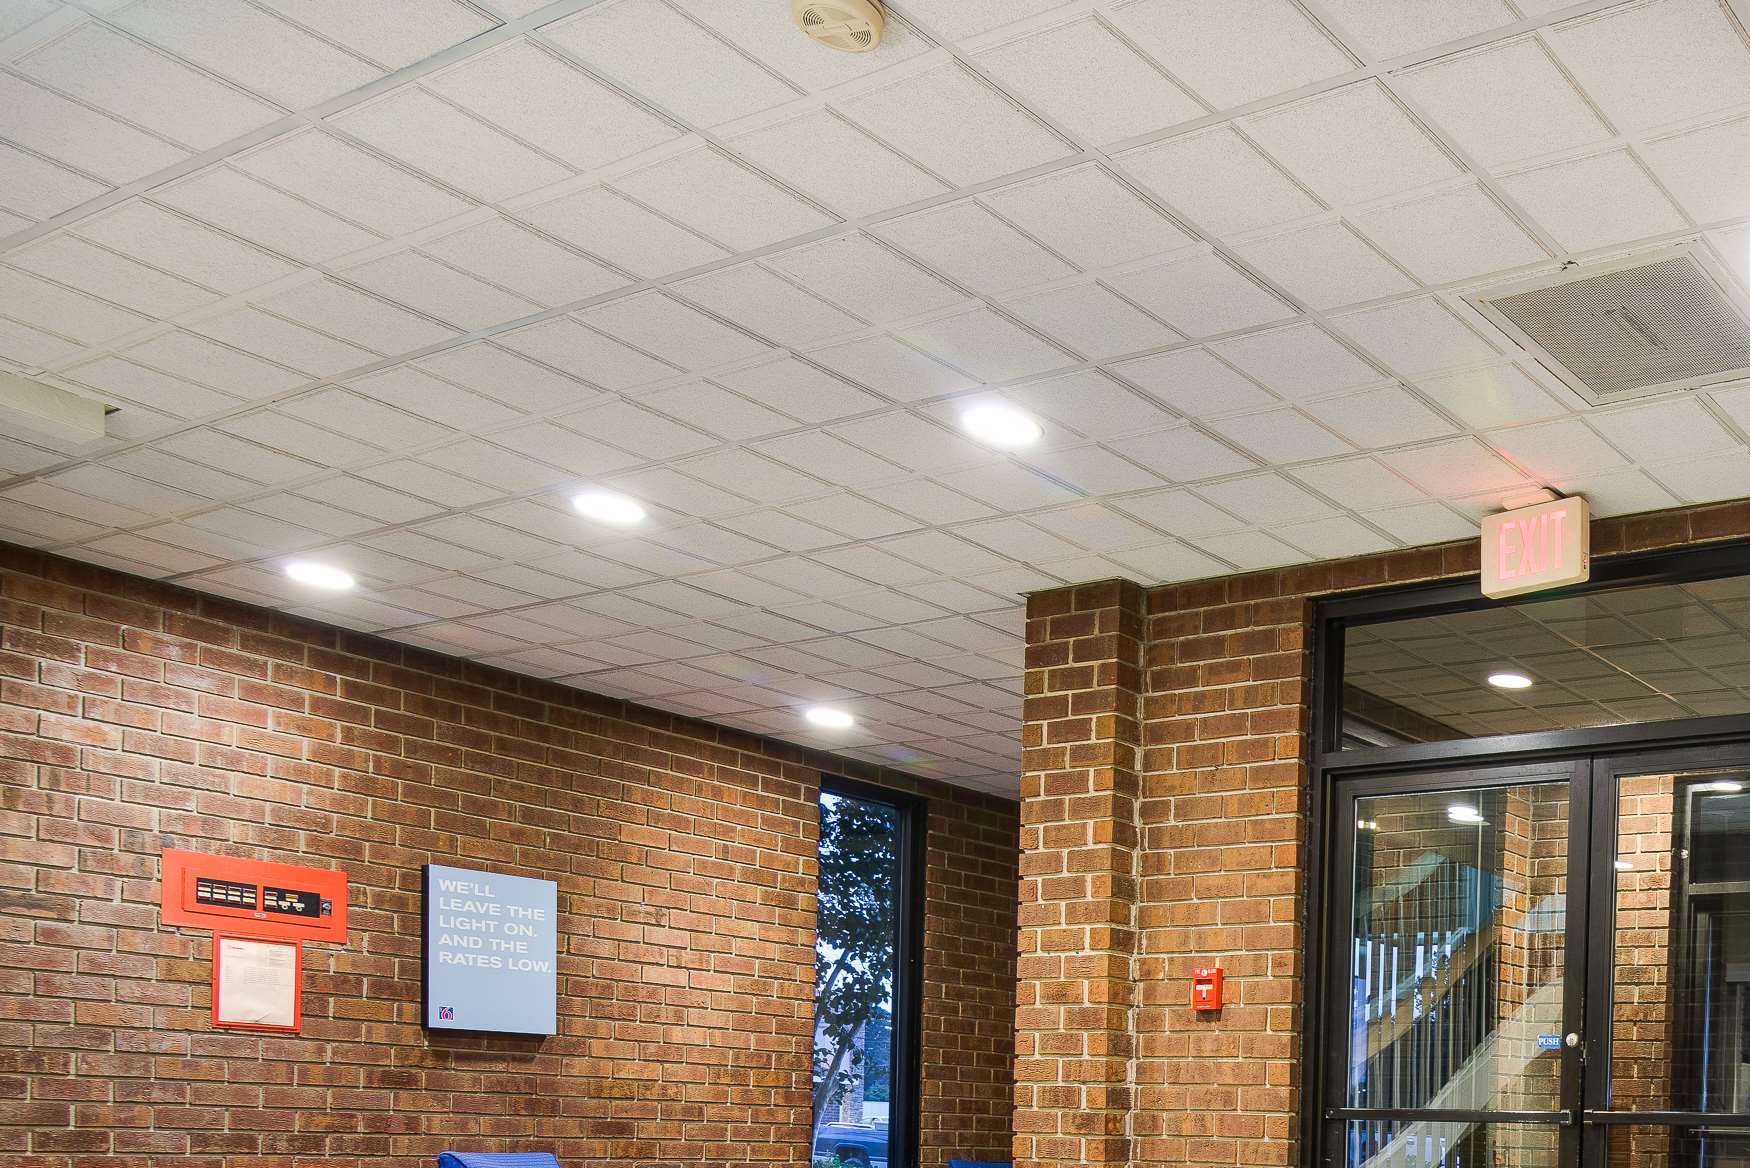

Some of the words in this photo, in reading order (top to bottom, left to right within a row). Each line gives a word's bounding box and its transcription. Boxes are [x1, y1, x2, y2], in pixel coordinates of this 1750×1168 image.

[1498, 508, 1569, 581] EXIT
[438, 878, 496, 898] WE'LL
[439, 897, 502, 916] LEAVE
[506, 905, 545, 921] THE
[439, 915, 498, 933] LIGHT
[503, 922, 538, 938] ON.
[438, 934, 483, 949] AND
[488, 938, 529, 954] THE
[439, 951, 502, 969] RATES
[508, 958, 552, 973] LOW.
[1538, 1037, 1559, 1046] PUSH
